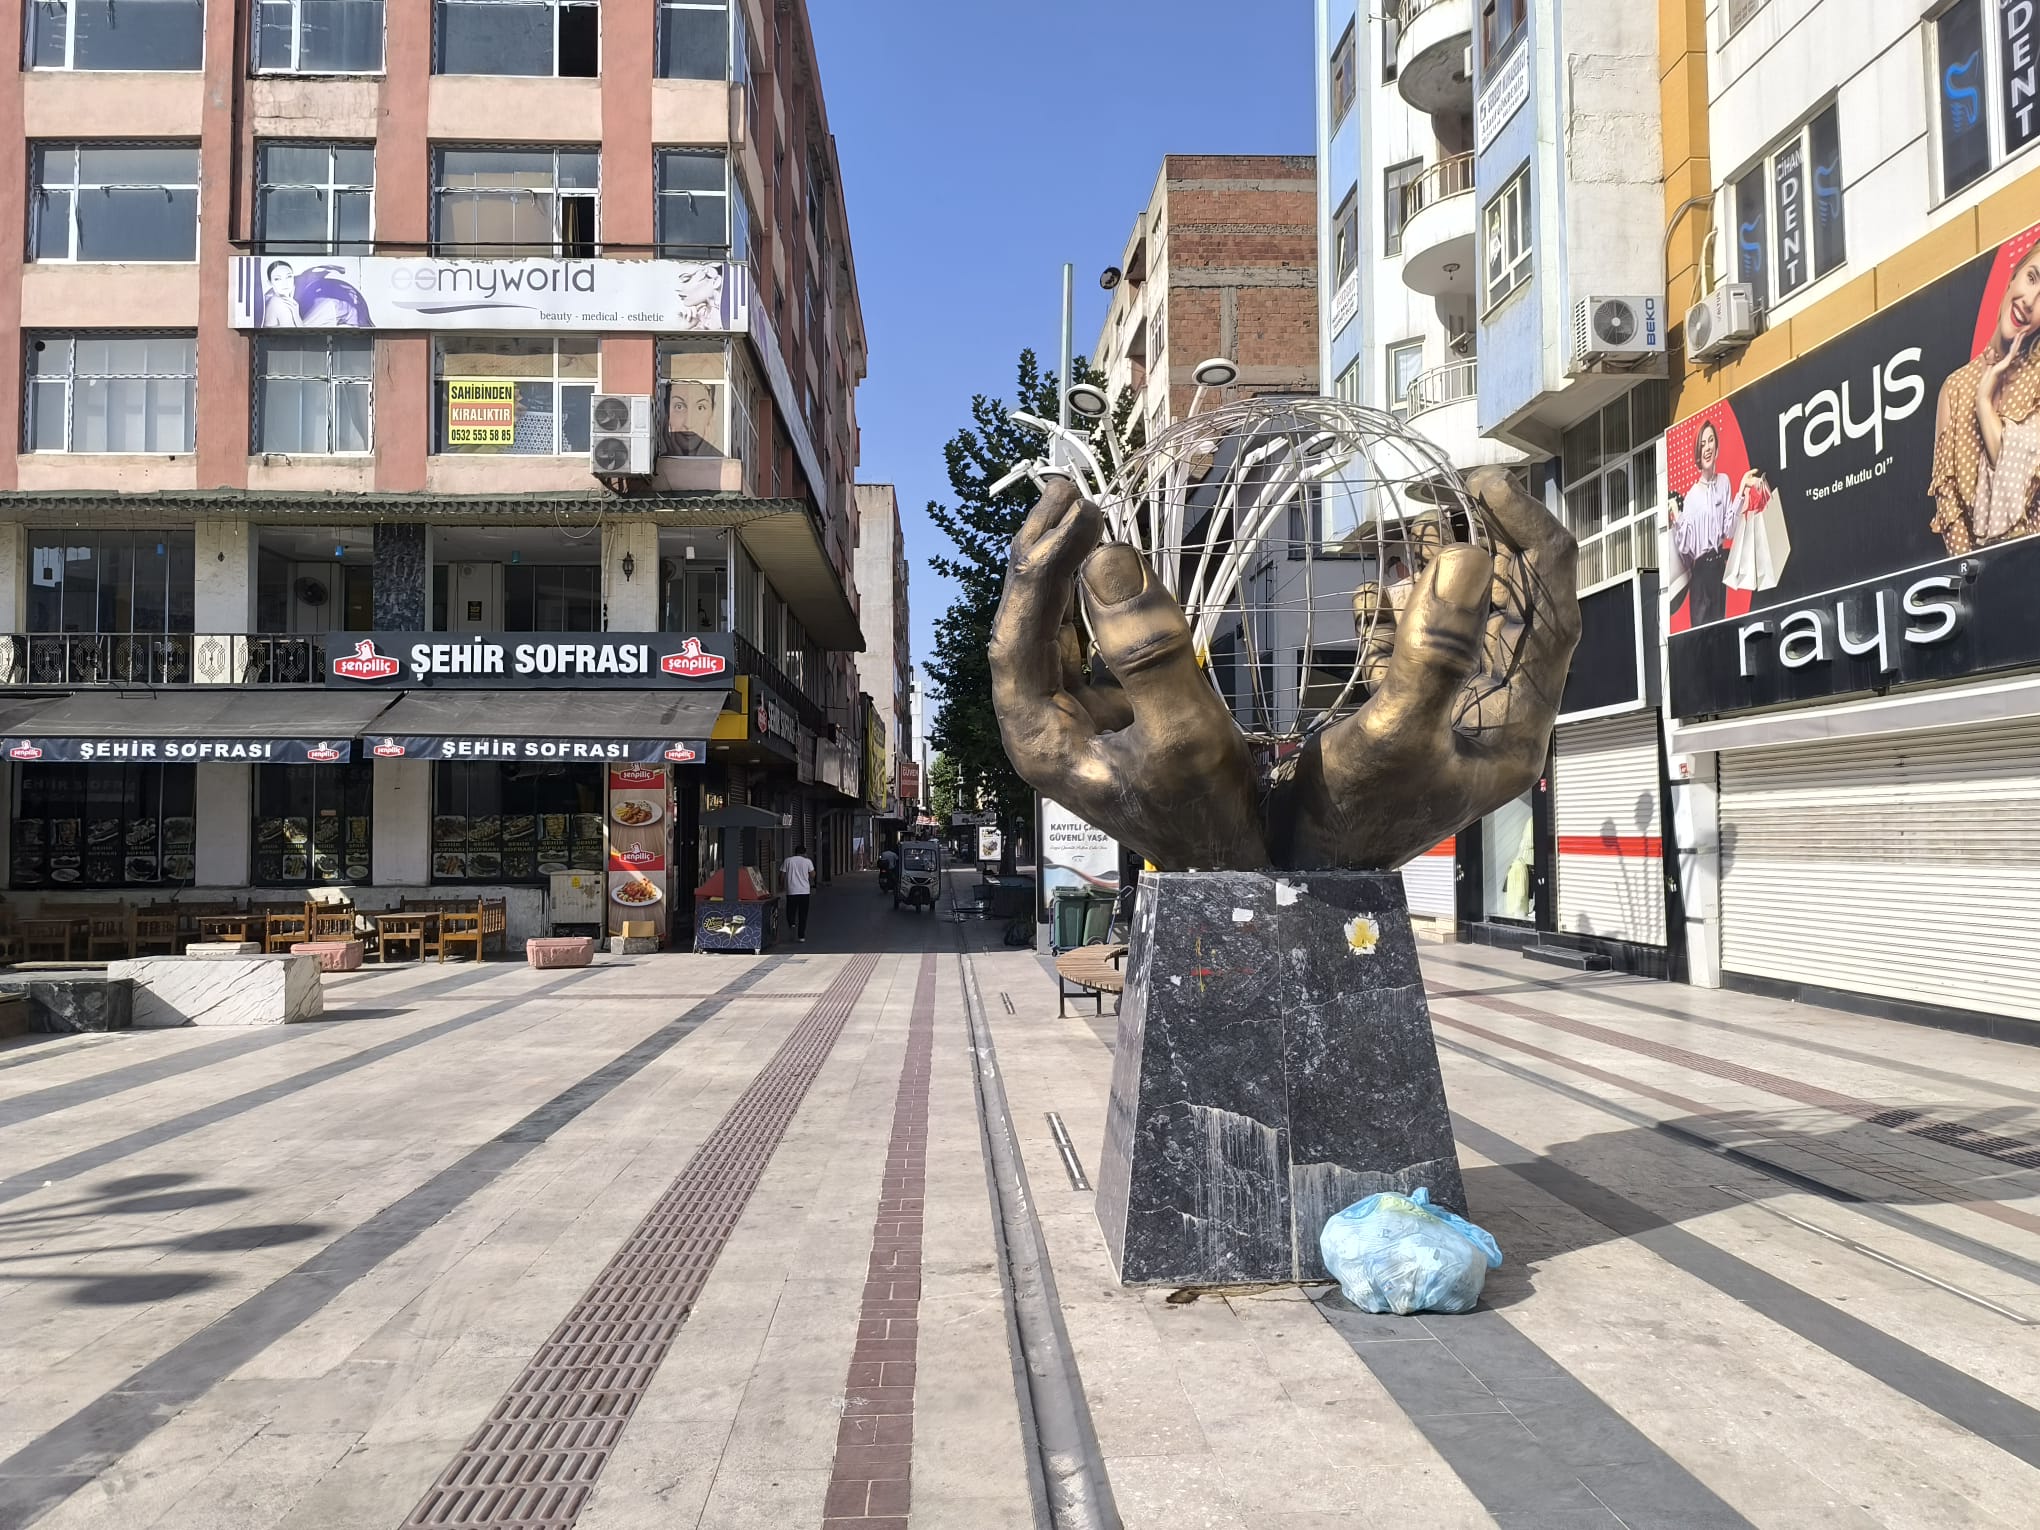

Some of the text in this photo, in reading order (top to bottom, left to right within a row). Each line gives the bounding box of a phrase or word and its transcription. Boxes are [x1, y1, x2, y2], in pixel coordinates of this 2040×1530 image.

[1780, 177, 1803, 286] DENT
[392, 264, 594, 298] esmyworld
[539, 310, 572, 324] beauty
[582, 309, 619, 322] medical
[627, 311, 664, 323] esthetic
[1646, 298, 1656, 346] BEKO
[451, 383, 513, 401] SAHİBİNDEN
[451, 406, 511, 423] KİRALIKTIR
[1778, 347, 1925, 470] rays
[451, 429, 512, 442] 0532 553 58 85
[1831, 480, 1844, 493] de
[1845, 468, 1873, 489] Mutlu
[1738, 576, 1963, 677] rays
[341, 635, 718, 682] şenpiliç ŞEHİR SOFRASI şenpiliç
[79, 738, 157, 760] ŞEHİR
[164, 743, 272, 758] SOFRASI
[442, 738, 517, 757] ŞEHİR
[524, 743, 630, 758] SOFRASI
[622, 769, 652, 781] şenpiliç
[1049, 832, 1108, 843] GÜVENLİ YAŞA
[1050, 823, 1082, 832] KAYITLI
[622, 851, 652, 863] şenpiliç
